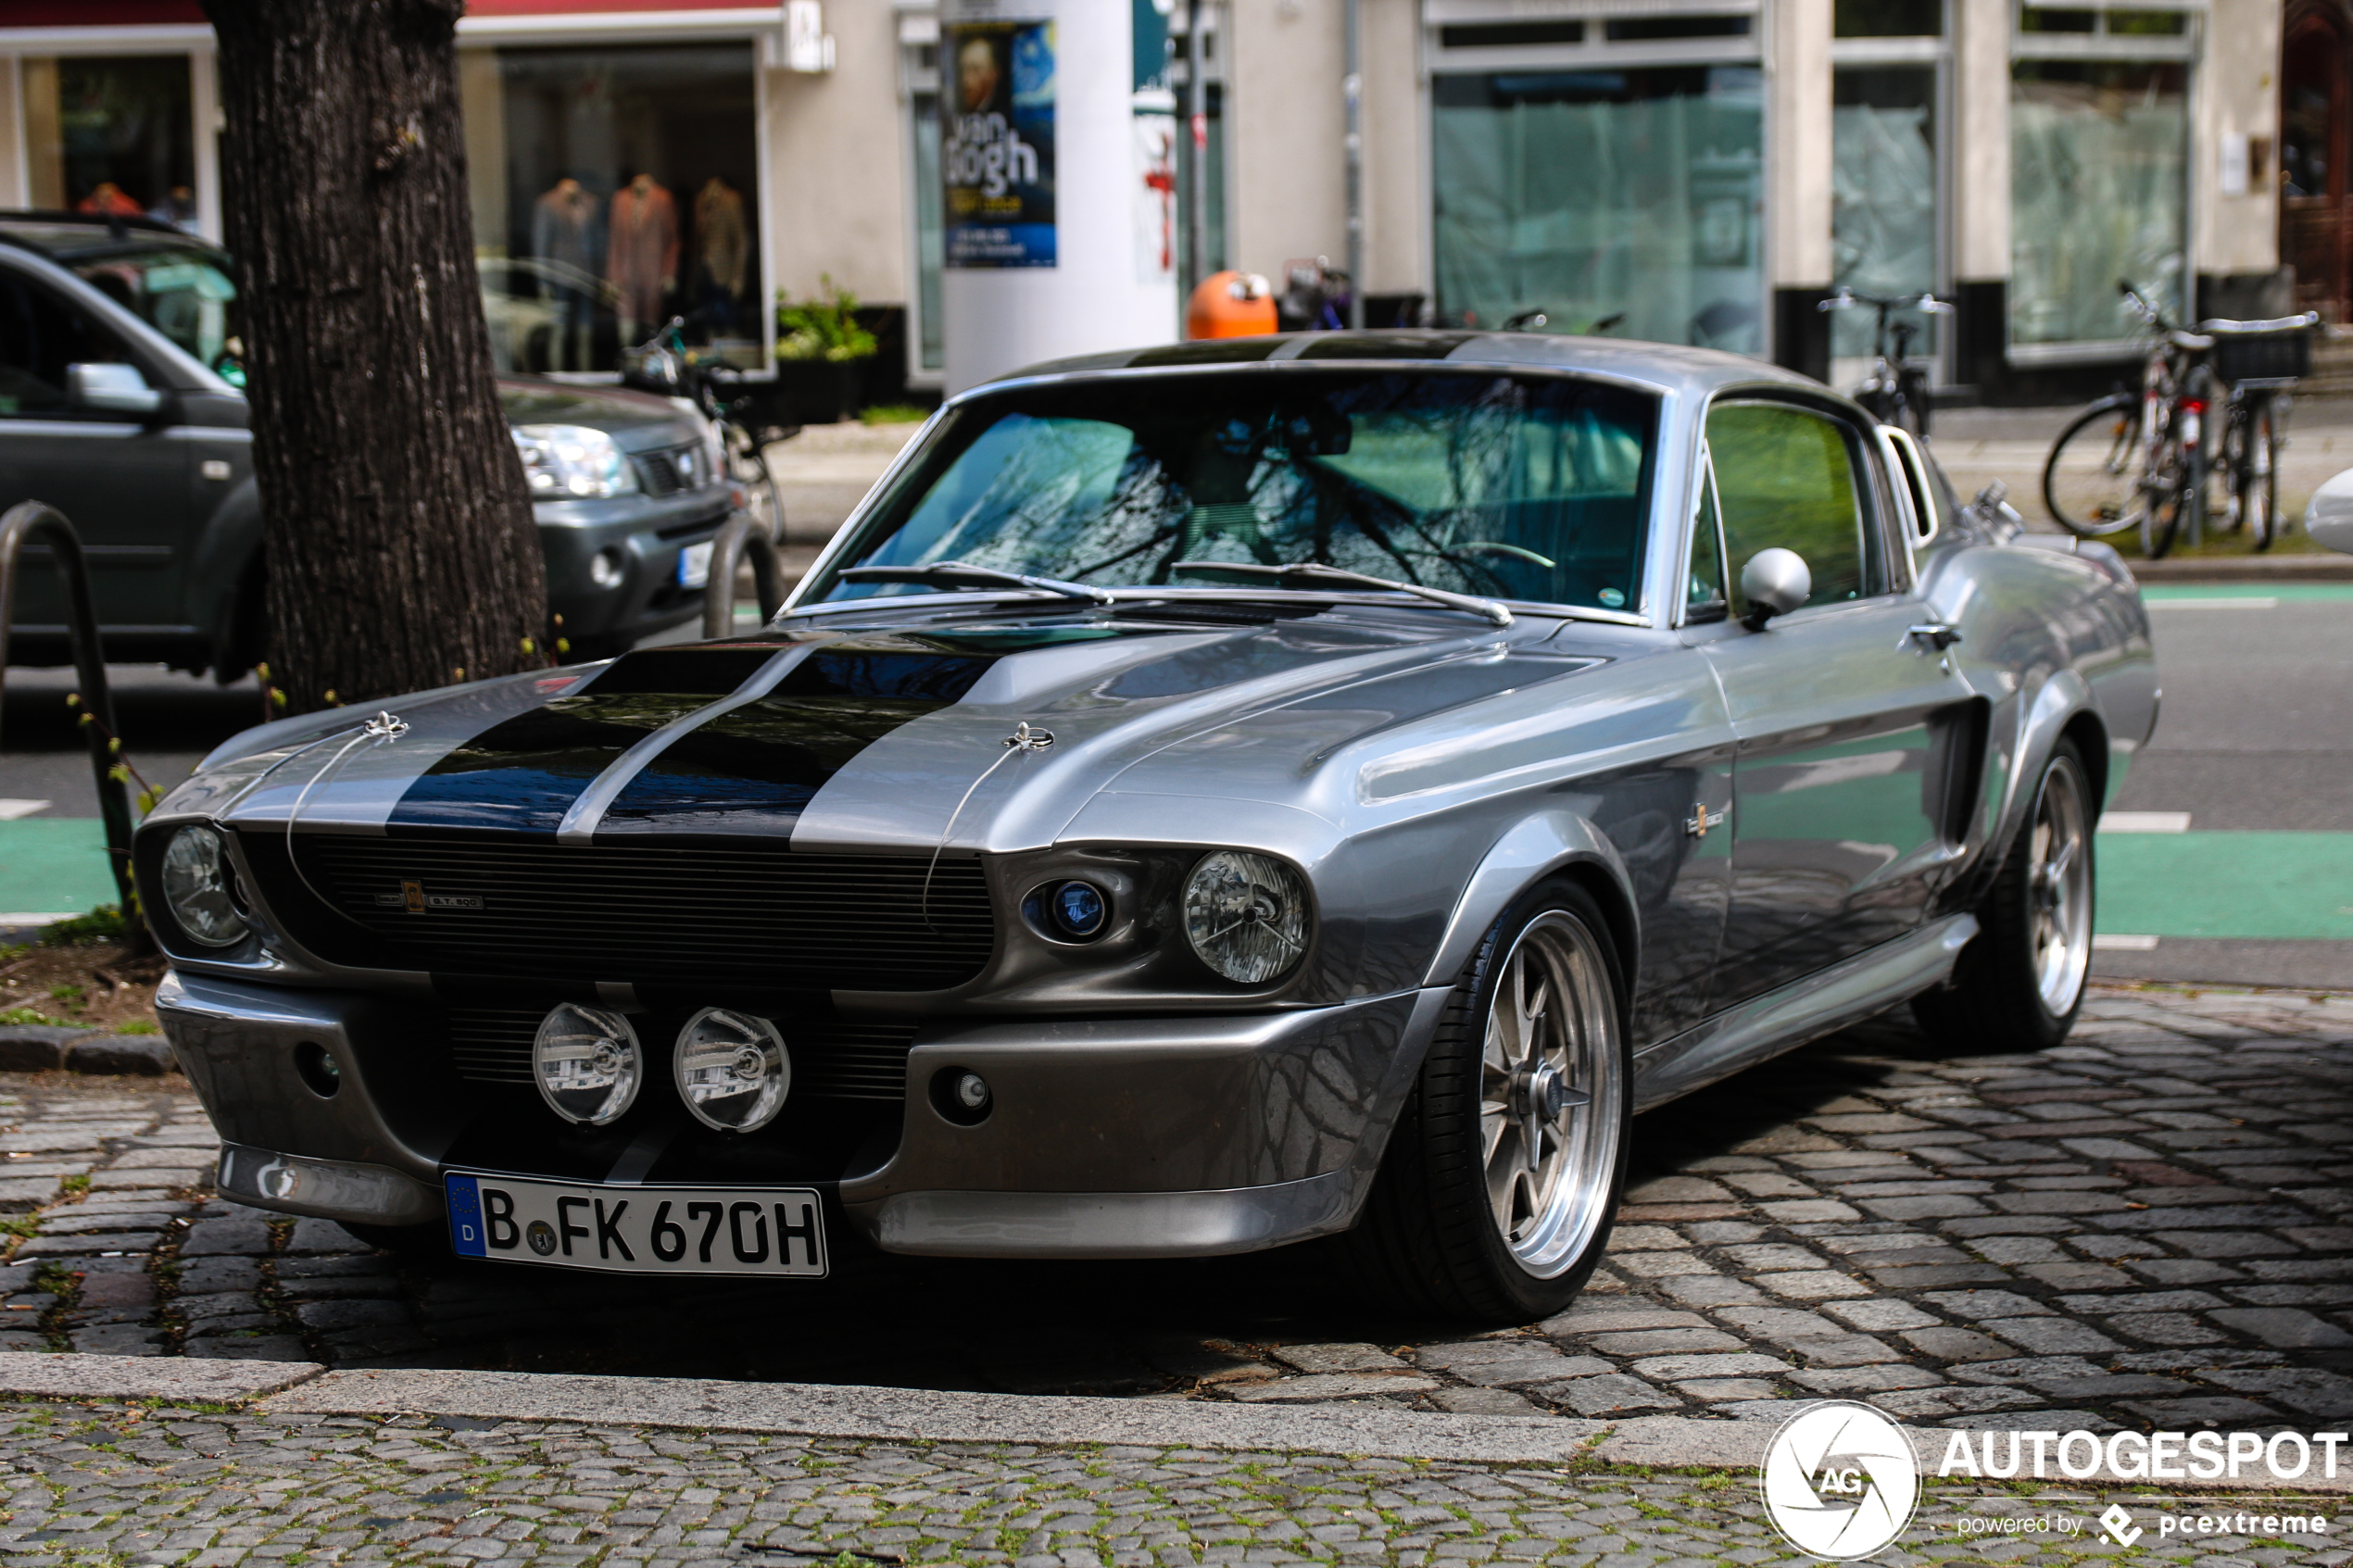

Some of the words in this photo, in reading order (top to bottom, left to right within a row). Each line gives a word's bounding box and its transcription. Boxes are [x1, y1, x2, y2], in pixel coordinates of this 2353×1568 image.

[461, 1224, 475, 1242] D
[482, 1186, 521, 1250] B
[556, 1195, 636, 1261] FK
[649, 1199, 819, 1266] 670H
